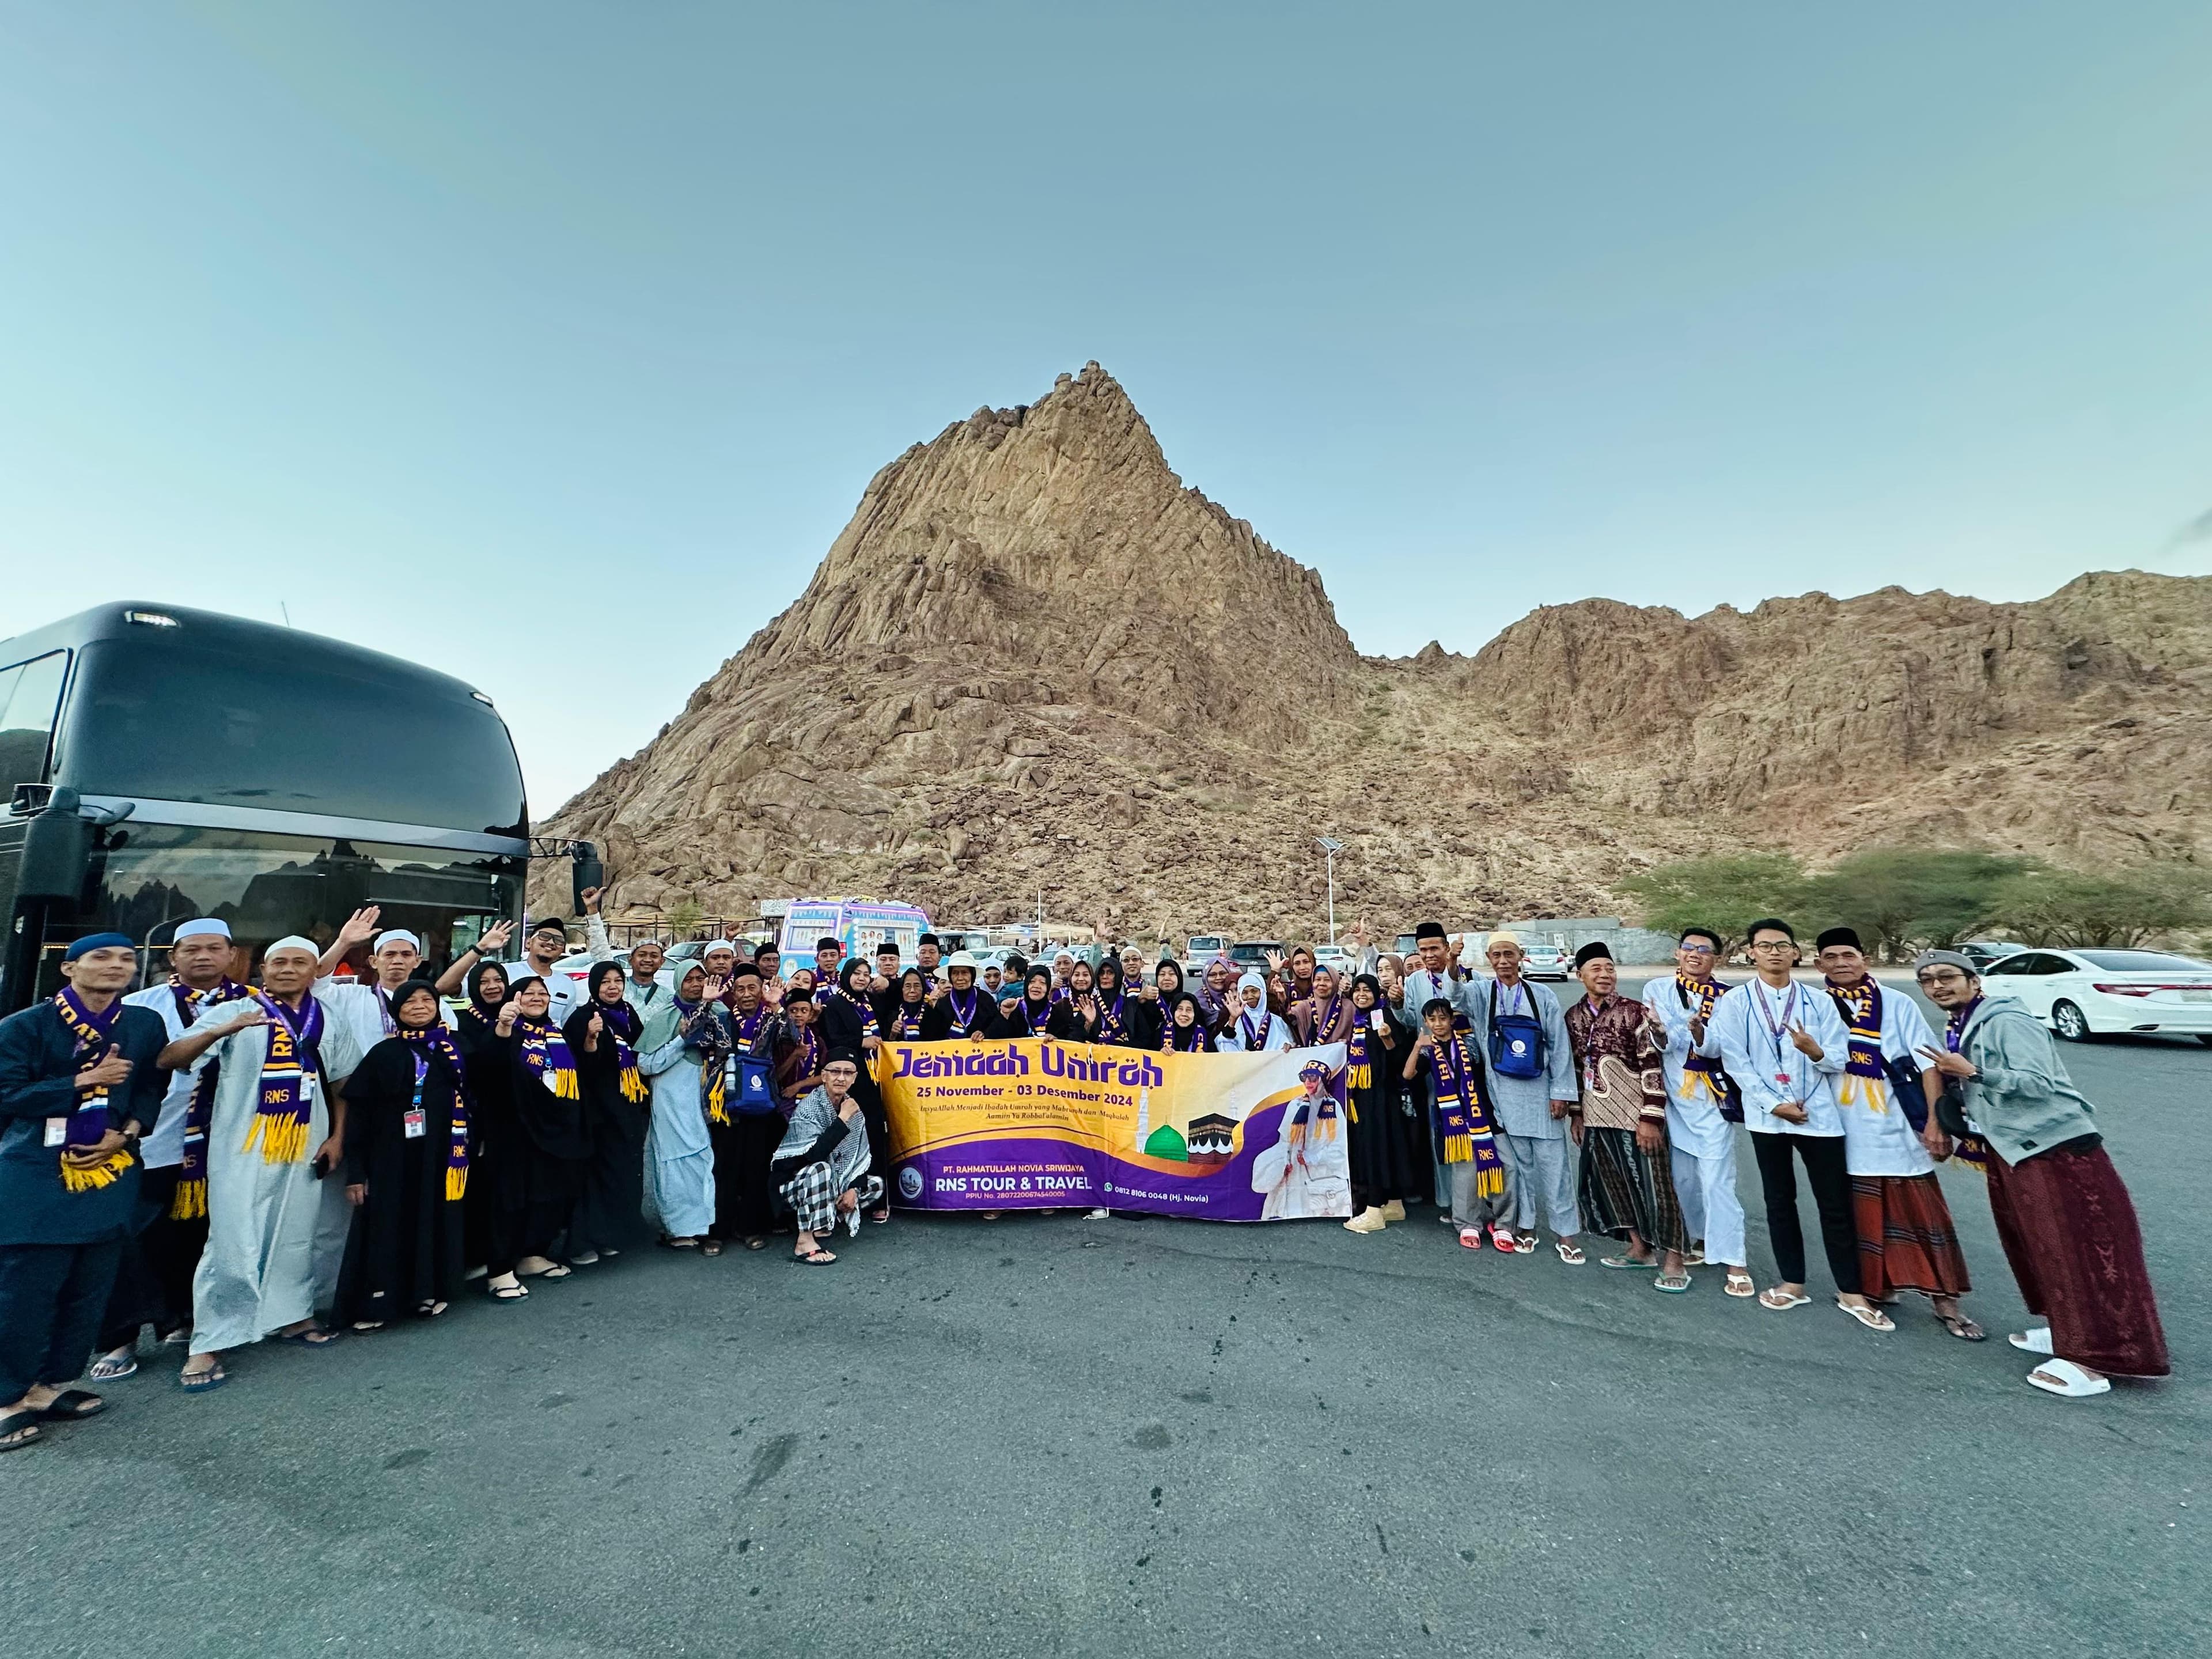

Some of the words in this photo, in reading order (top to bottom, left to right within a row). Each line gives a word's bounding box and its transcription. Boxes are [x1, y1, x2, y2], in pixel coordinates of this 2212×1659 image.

[527, 1053, 544, 1066] RNS
[893, 1043, 1029, 1080] Jemaah
[1851, 1051, 1873, 1065] RNS
[265, 1089, 290, 1104] RNS
[917, 1086, 931, 1097] 25
[936, 1085, 1003, 1097] November
[1017, 1085, 1032, 1095] 03
[1037, 1085, 1100, 1101] Desember
[1104, 1093, 1133, 1106] 2024
[1449, 1116, 1464, 1126] RNS
[1478, 1149, 1494, 1160] RNS
[956, 1165, 1016, 1173] RAHMATULLAH
[1045, 1164, 1085, 1172] SRIWIJAYA
[935, 1178, 967, 1191] RNS
[971, 1177, 1016, 1191] TOUR
[1020, 1177, 1031, 1190] &
[1035, 1176, 1092, 1190] TRAVEL
[1115, 1186, 1130, 1195] 0812
[1131, 1189, 1146, 1198] 8106
[1148, 1192, 1168, 1200] 0048
[1169, 1193, 1182, 1203] (Hj.
[1184, 1195, 1209, 1203] Novia)
